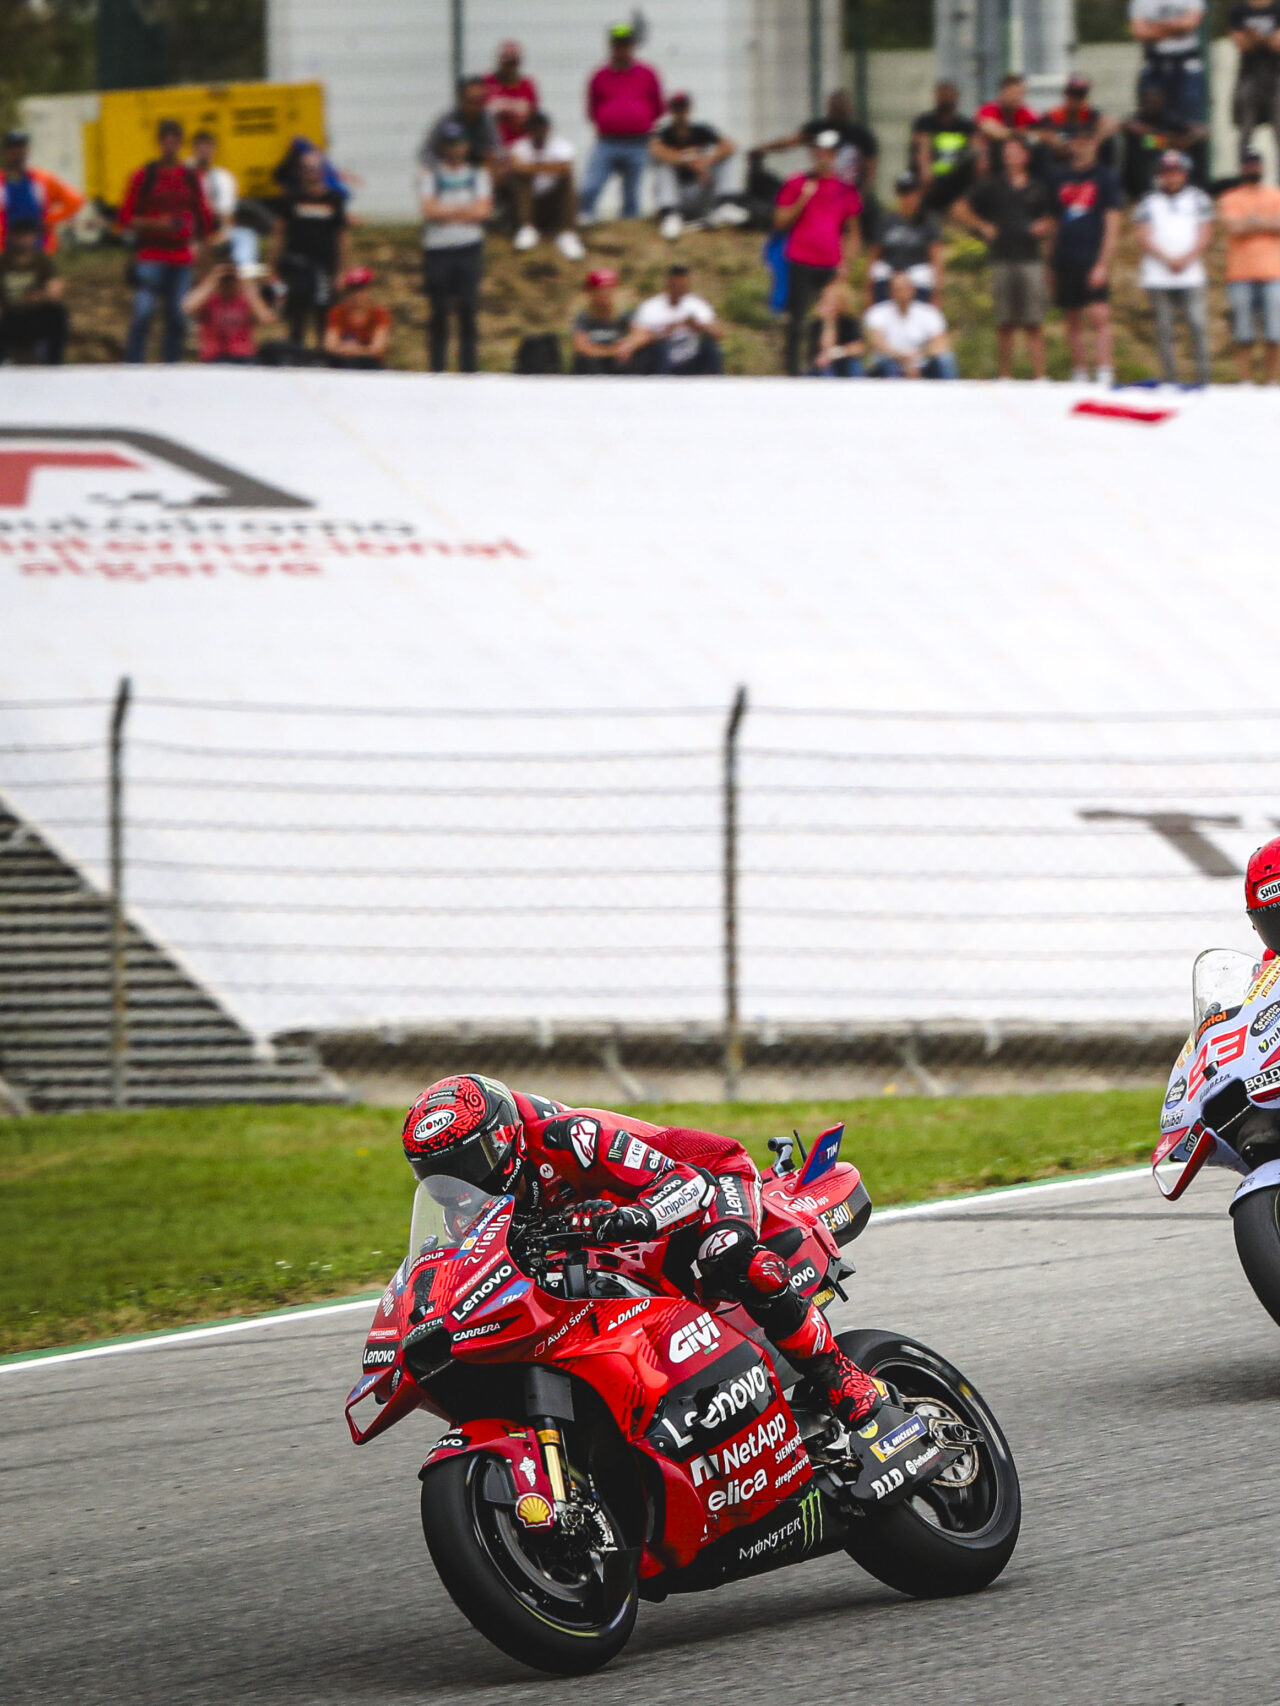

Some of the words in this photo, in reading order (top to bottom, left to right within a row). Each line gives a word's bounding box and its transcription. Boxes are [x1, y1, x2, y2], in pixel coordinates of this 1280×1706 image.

[1244, 1067, 1280, 1089] BOLD
[415, 1115, 450, 1136] SUOMY
[826, 1142, 840, 1160] TIM
[502, 1158, 522, 1192] Lenovo
[645, 1179, 682, 1205] Lenovo
[656, 1184, 700, 1219] UnipolSai
[719, 1176, 735, 1216] Lenovo
[475, 1214, 511, 1255] riello
[452, 1264, 513, 1322] Lenovo
[547, 1320, 570, 1346] Audi
[568, 1301, 595, 1327] Sport
[617, 1298, 651, 1325] DAIKO
[453, 1321, 502, 1343] CARRERA
[668, 1311, 721, 1363] GIVI
[363, 1348, 396, 1365] Lenovo
[661, 1364, 767, 1449] Lenovo
[722, 1412, 787, 1476] NetApp
[774, 1434, 802, 1464] SIEMENS
[892, 1423, 921, 1446] MICHELIN
[707, 1468, 768, 1513] elica
[738, 1516, 802, 1561] MONSTER
